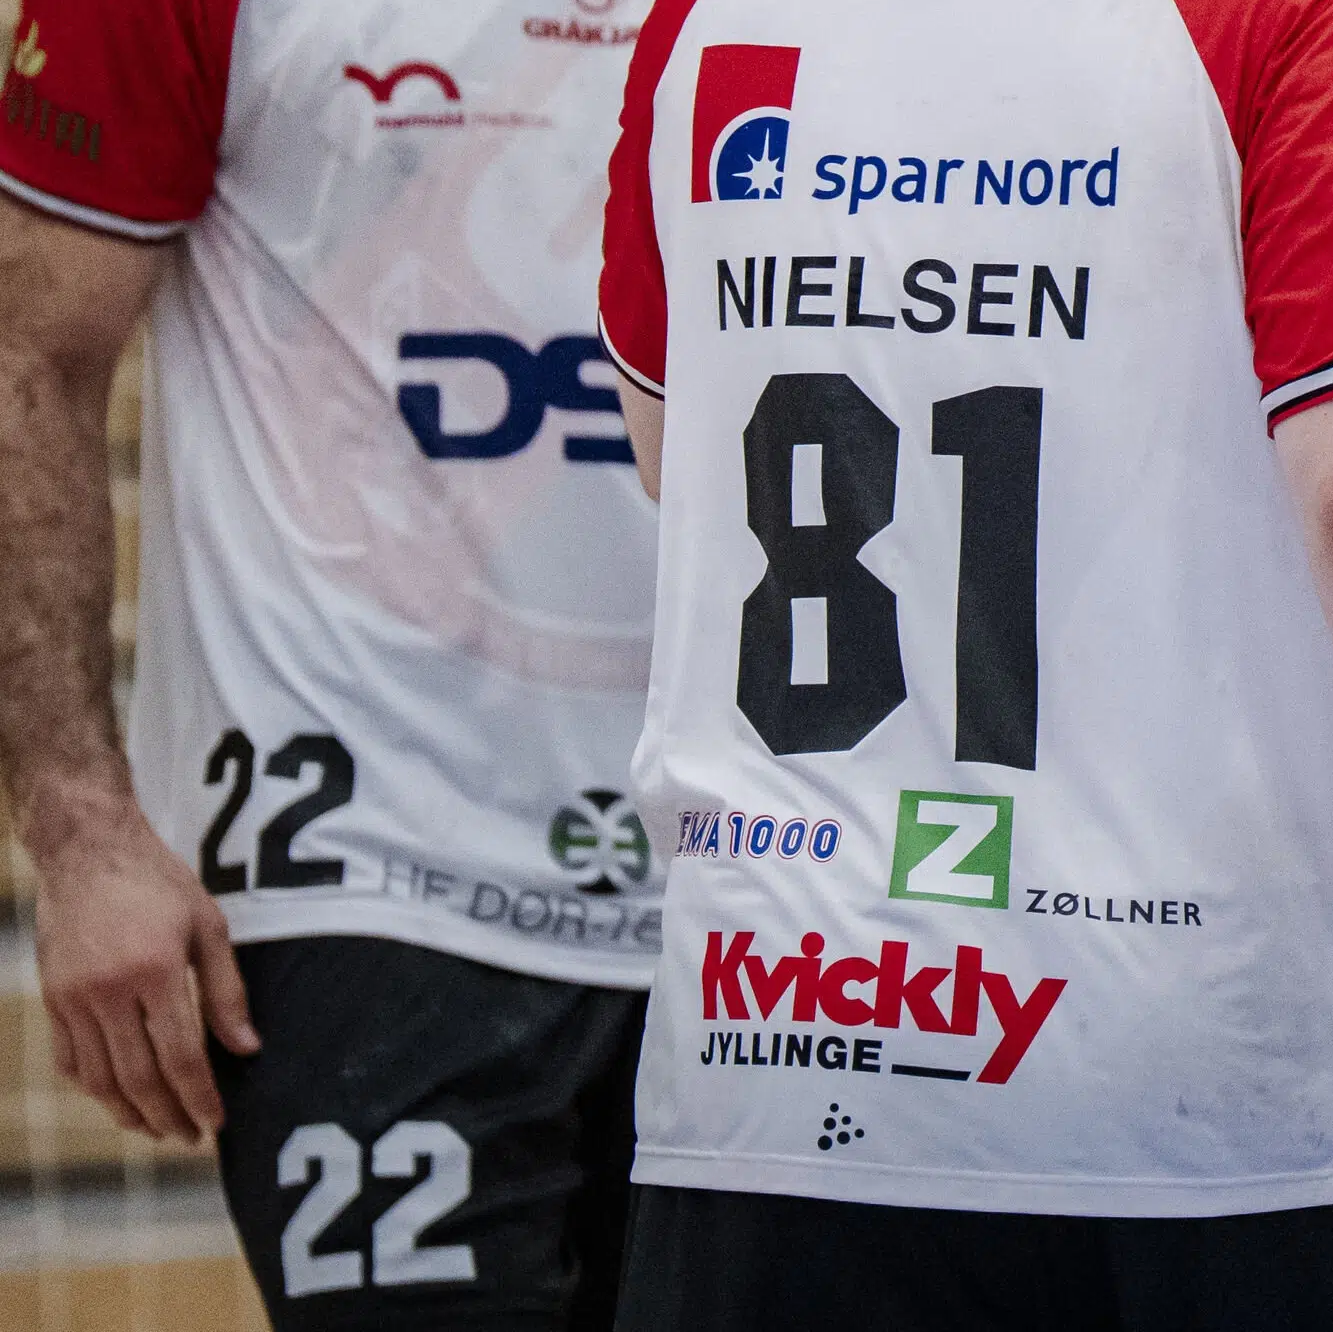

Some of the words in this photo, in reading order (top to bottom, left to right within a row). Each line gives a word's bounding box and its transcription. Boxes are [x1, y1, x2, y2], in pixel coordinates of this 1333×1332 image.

[811, 153, 964, 215] spar
[974, 145, 1119, 208] Nord
[716, 255, 1090, 341] NIELSEN
[398, 332, 637, 464] DS
[736, 372, 1044, 772] 81
[200, 728, 356, 895] 22
[676, 811, 720, 858] EMA
[727, 811, 842, 863] 1000
[1025, 888, 1202, 927] ZØLLNER
[700, 1031, 884, 1074] JYLLINGE
[702, 931, 1068, 1085] Kvickly
[276, 1119, 478, 1300] 22
